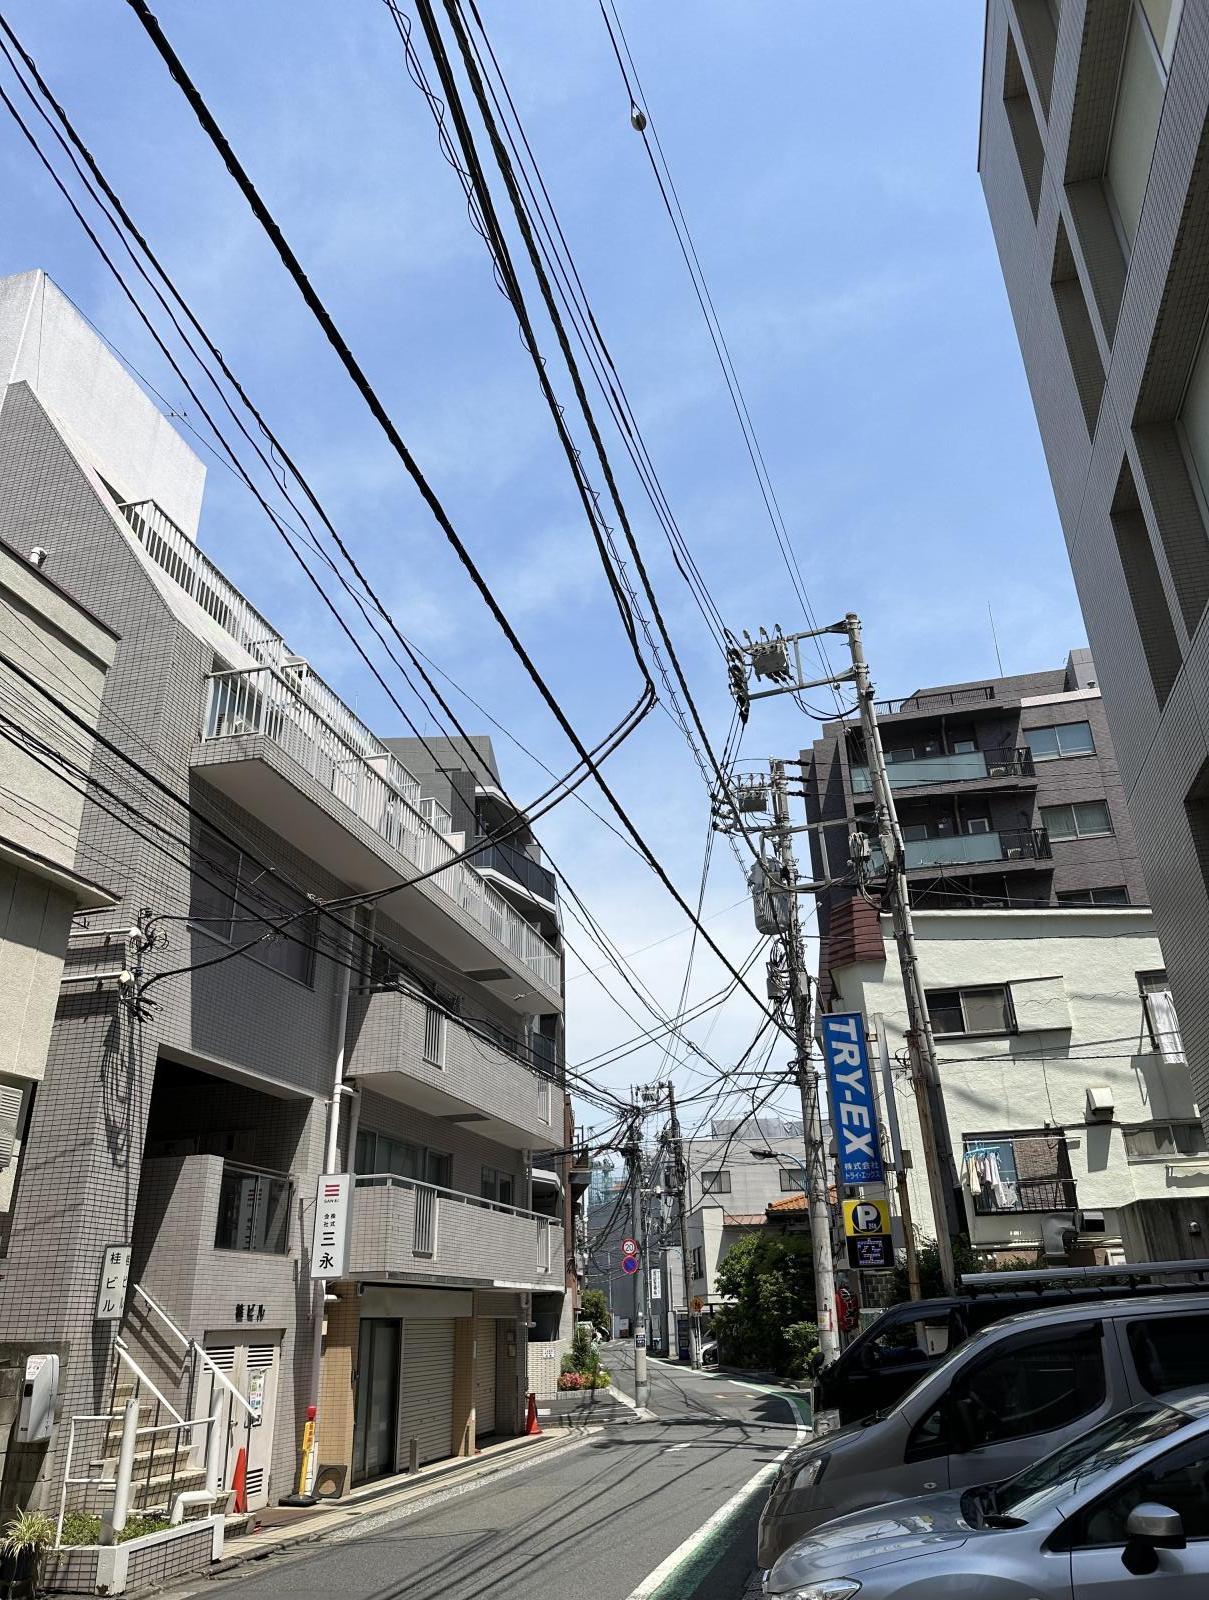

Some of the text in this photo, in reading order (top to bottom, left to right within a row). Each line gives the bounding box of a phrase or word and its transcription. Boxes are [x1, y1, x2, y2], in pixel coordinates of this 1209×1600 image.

[829, 1019, 874, 1158] TRY-EX
[844, 1162, 880, 1171] 株式会社
[857, 1205, 878, 1230] P
[319, 1232, 336, 1269] 三永
[625, 1243, 634, 1252] 20
[103, 1252, 121, 1312] 桂ビル
